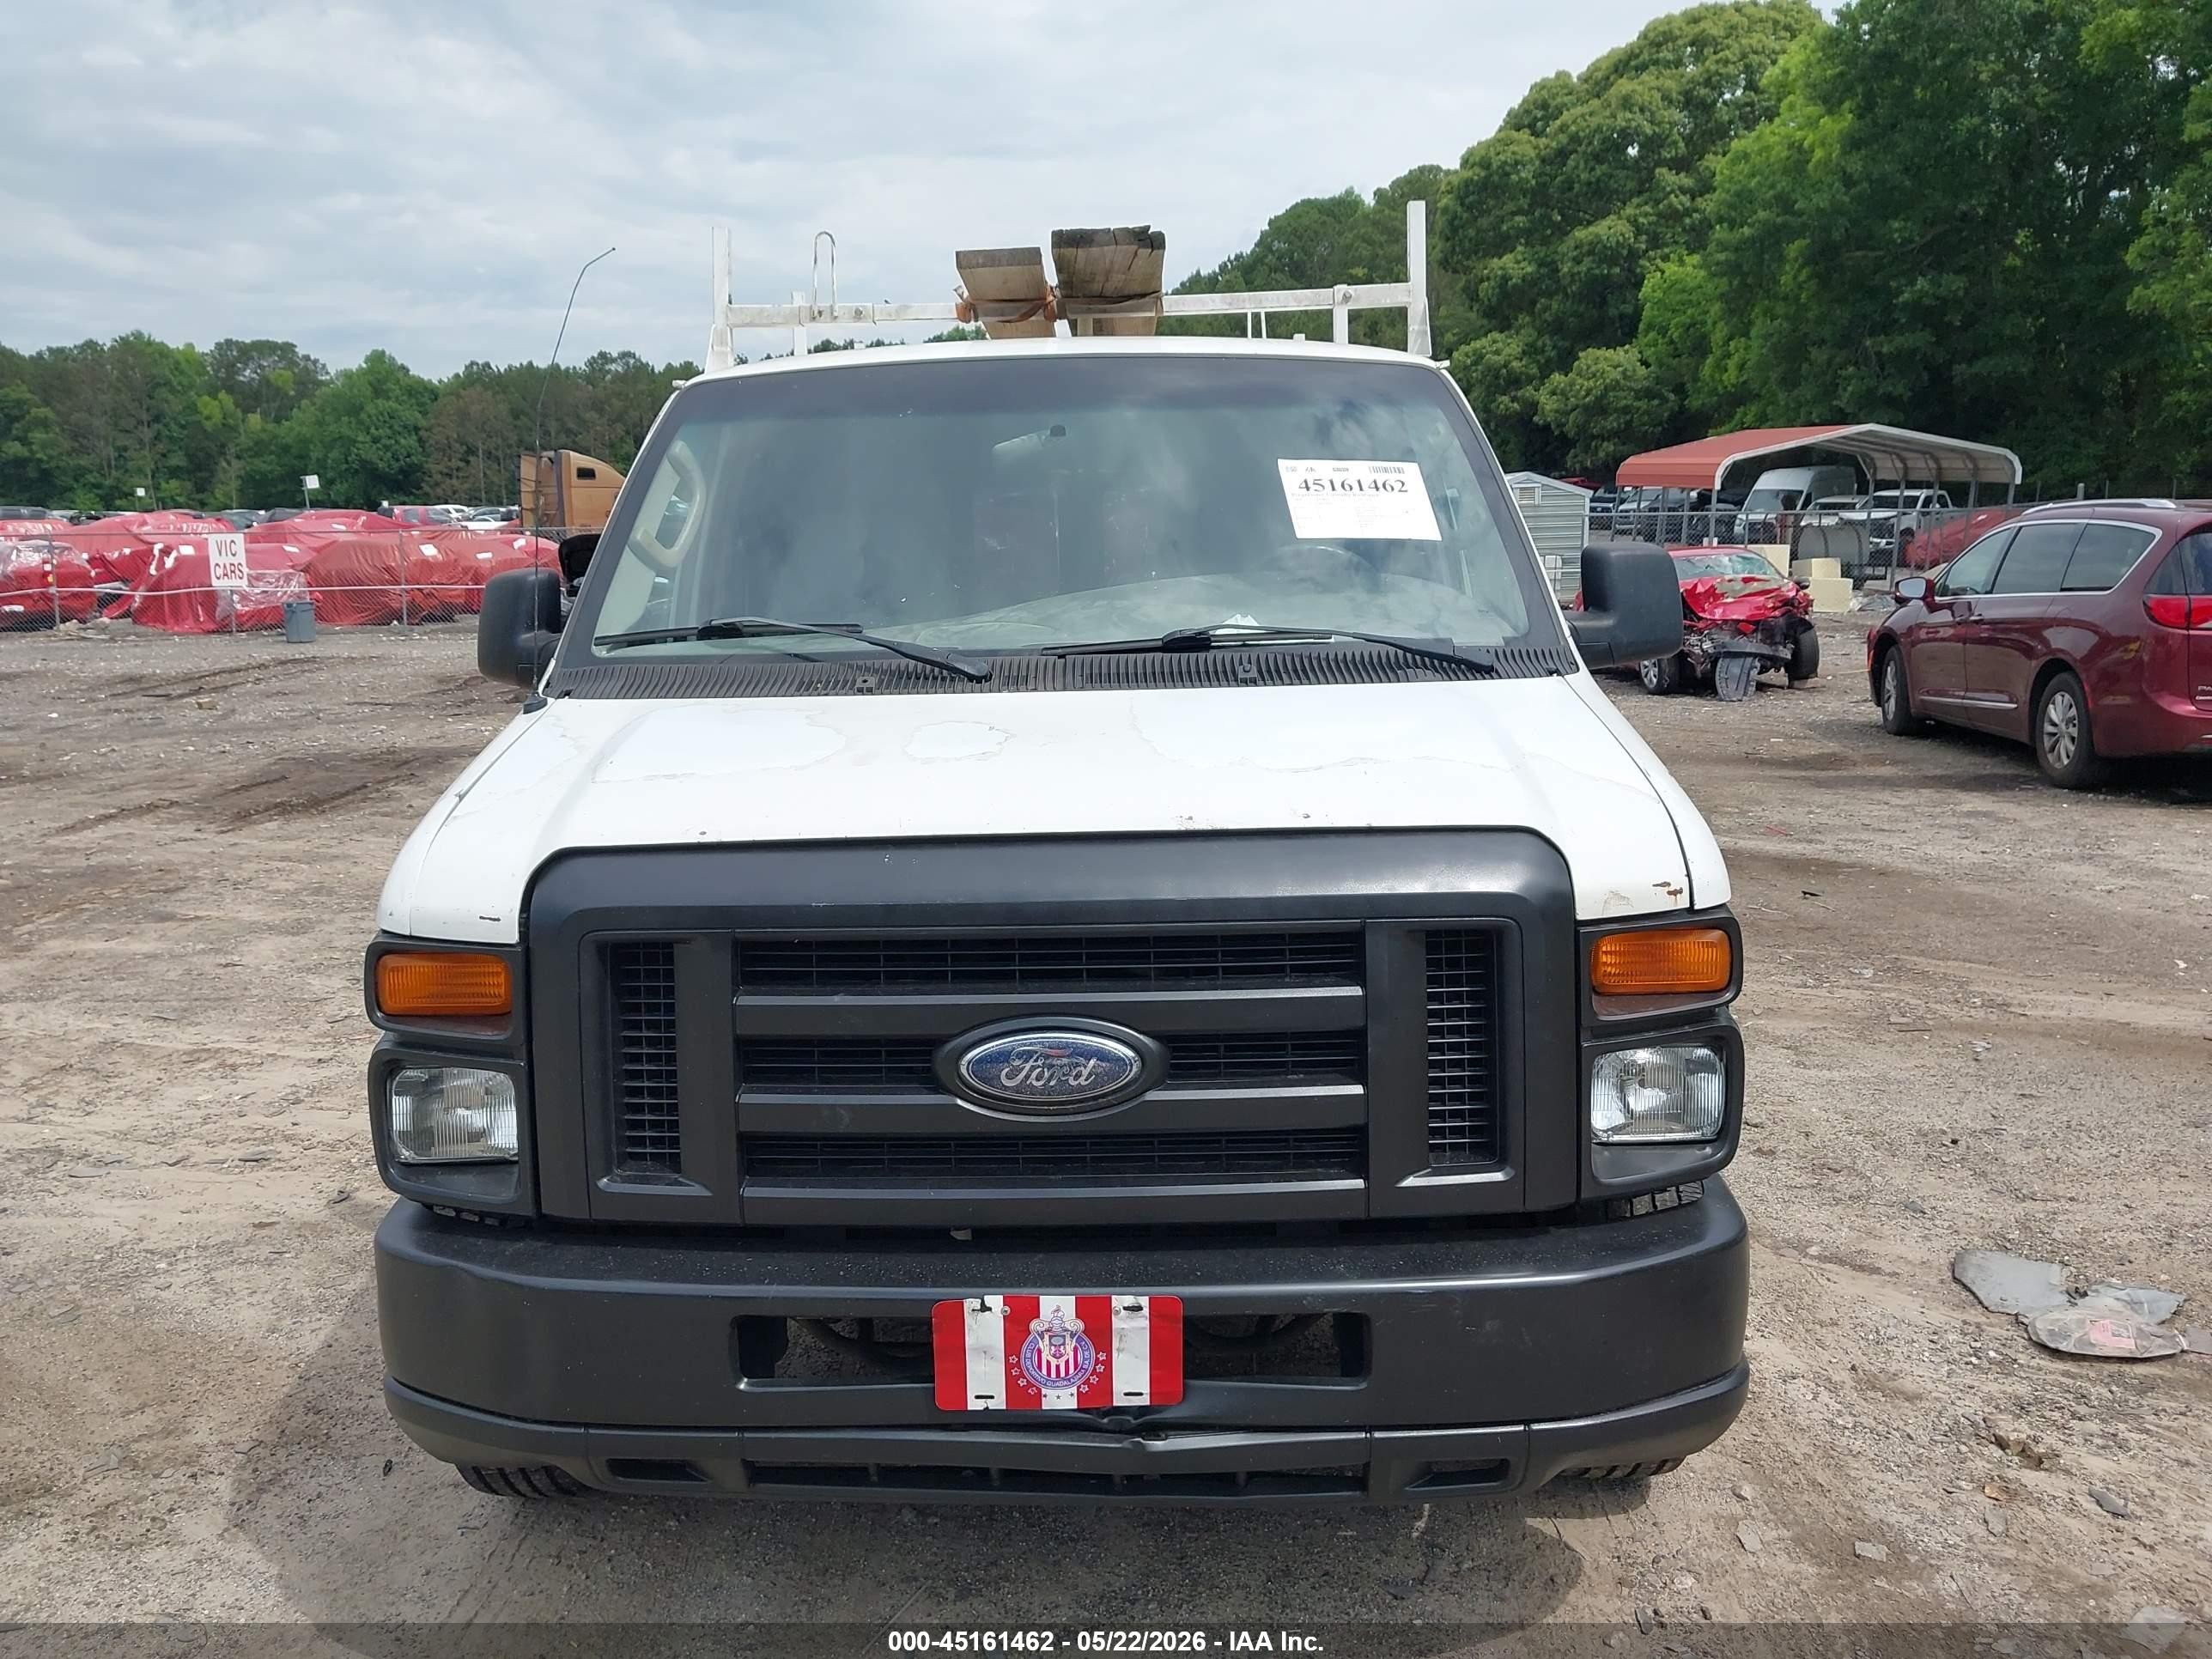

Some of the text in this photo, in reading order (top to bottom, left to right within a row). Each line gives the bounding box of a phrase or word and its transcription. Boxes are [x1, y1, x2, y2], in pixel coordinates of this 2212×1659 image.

[1298, 478, 1408, 493] 45161462
[216, 539, 237, 556] VIC
[214, 562, 244, 580] CARS
[1000, 1046, 1098, 1087] Ford
[1025, 1342, 1036, 1357] CLUB
